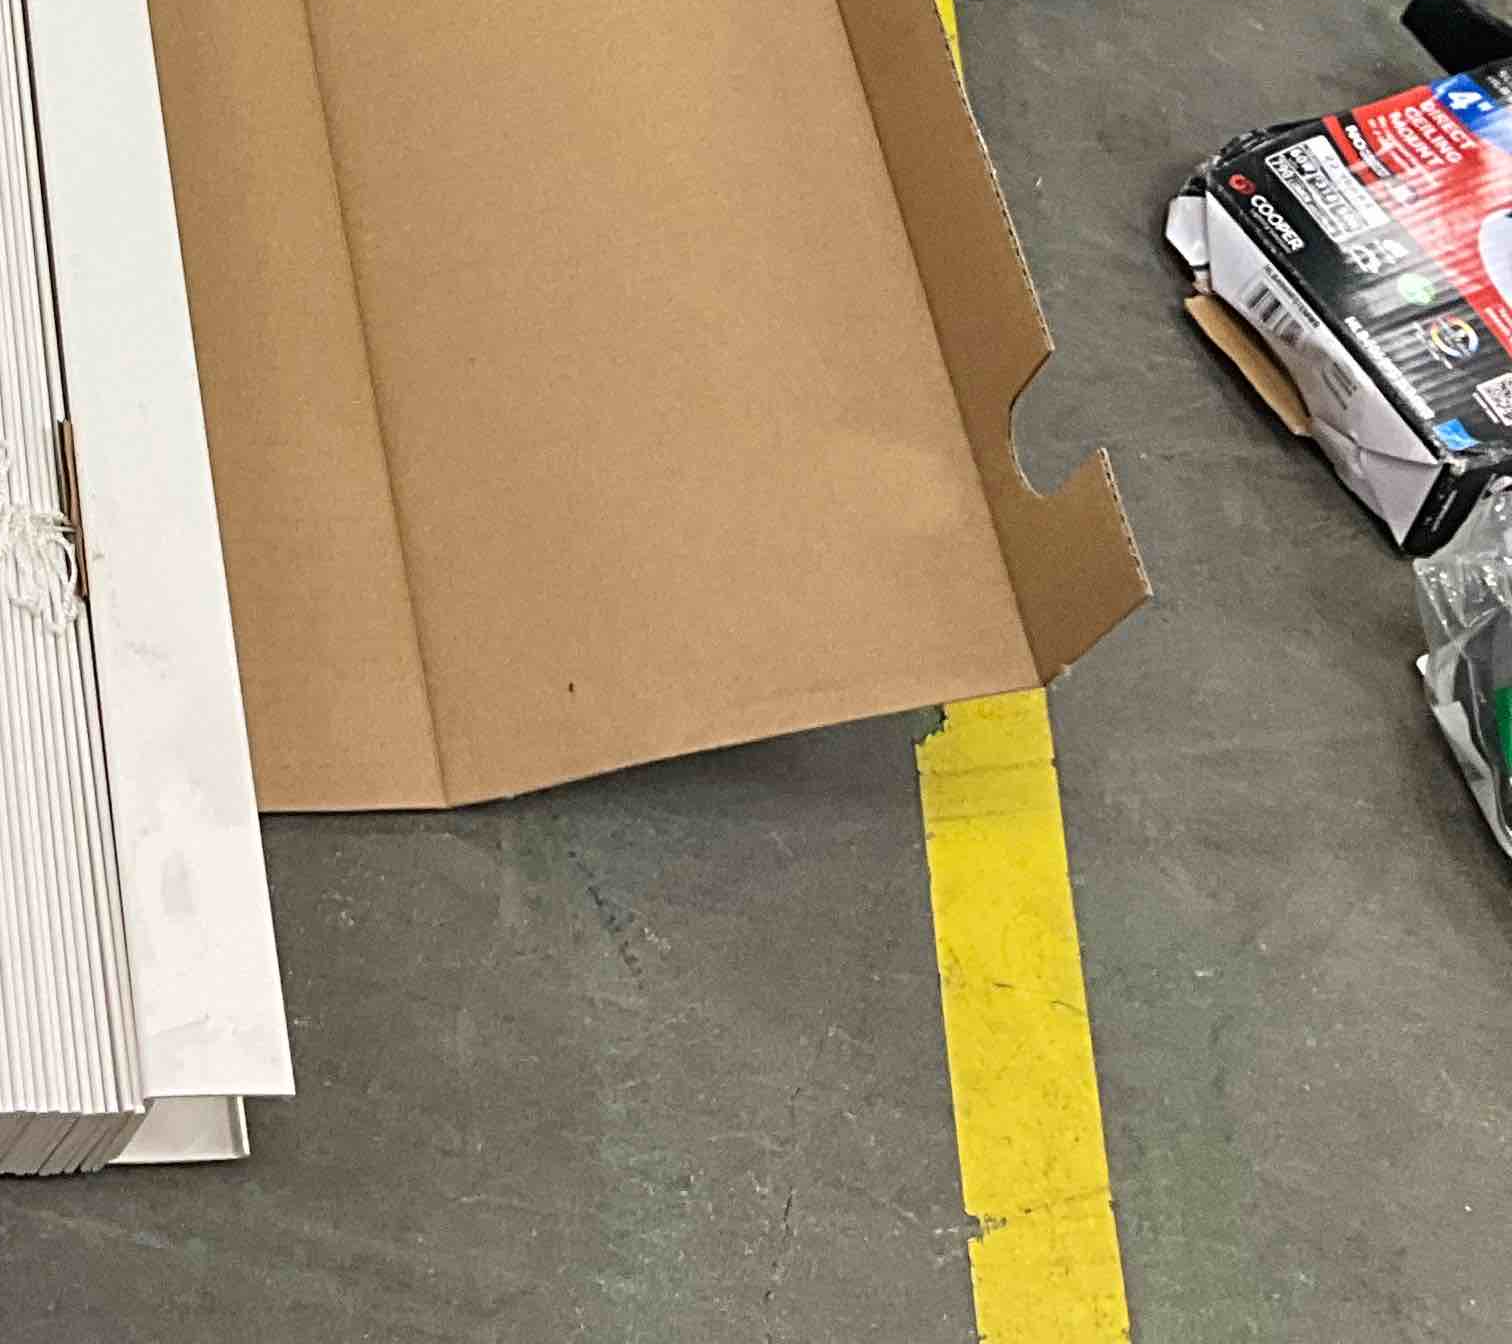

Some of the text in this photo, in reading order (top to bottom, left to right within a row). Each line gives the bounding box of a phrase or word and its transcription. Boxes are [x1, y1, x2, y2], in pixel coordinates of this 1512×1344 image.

[1388, 109, 1446, 165] MOUNT
[1404, 107, 1463, 164] CEILING
[1419, 98, 1478, 150] DIRECT
[1249, 193, 1305, 253] COOPER
